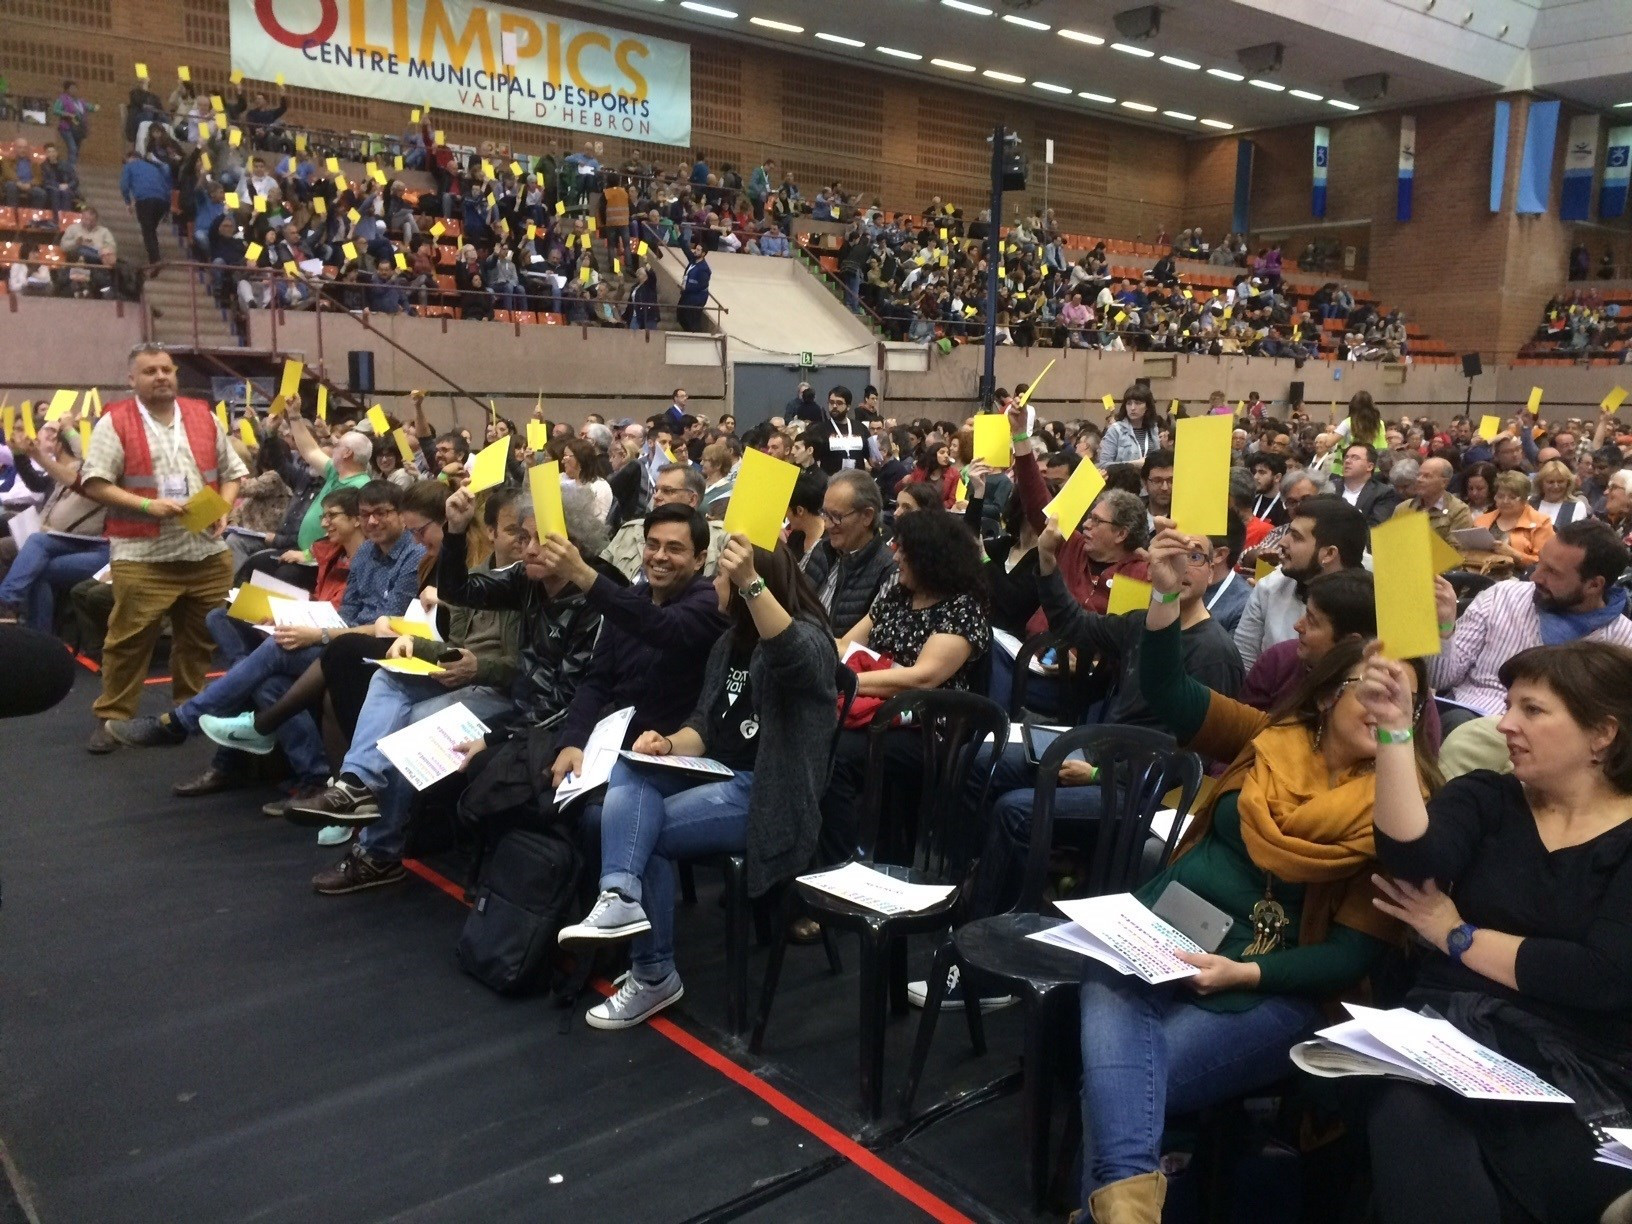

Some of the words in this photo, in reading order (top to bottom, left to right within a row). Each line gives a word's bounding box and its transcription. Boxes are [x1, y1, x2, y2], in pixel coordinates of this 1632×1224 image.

[302, 38, 399, 75] CENTRE
[408, 57, 536, 99] MUNICIPAL
[542, 80, 650, 118] D'ESPORTS
[535, 102, 650, 135] D'HEBRON
